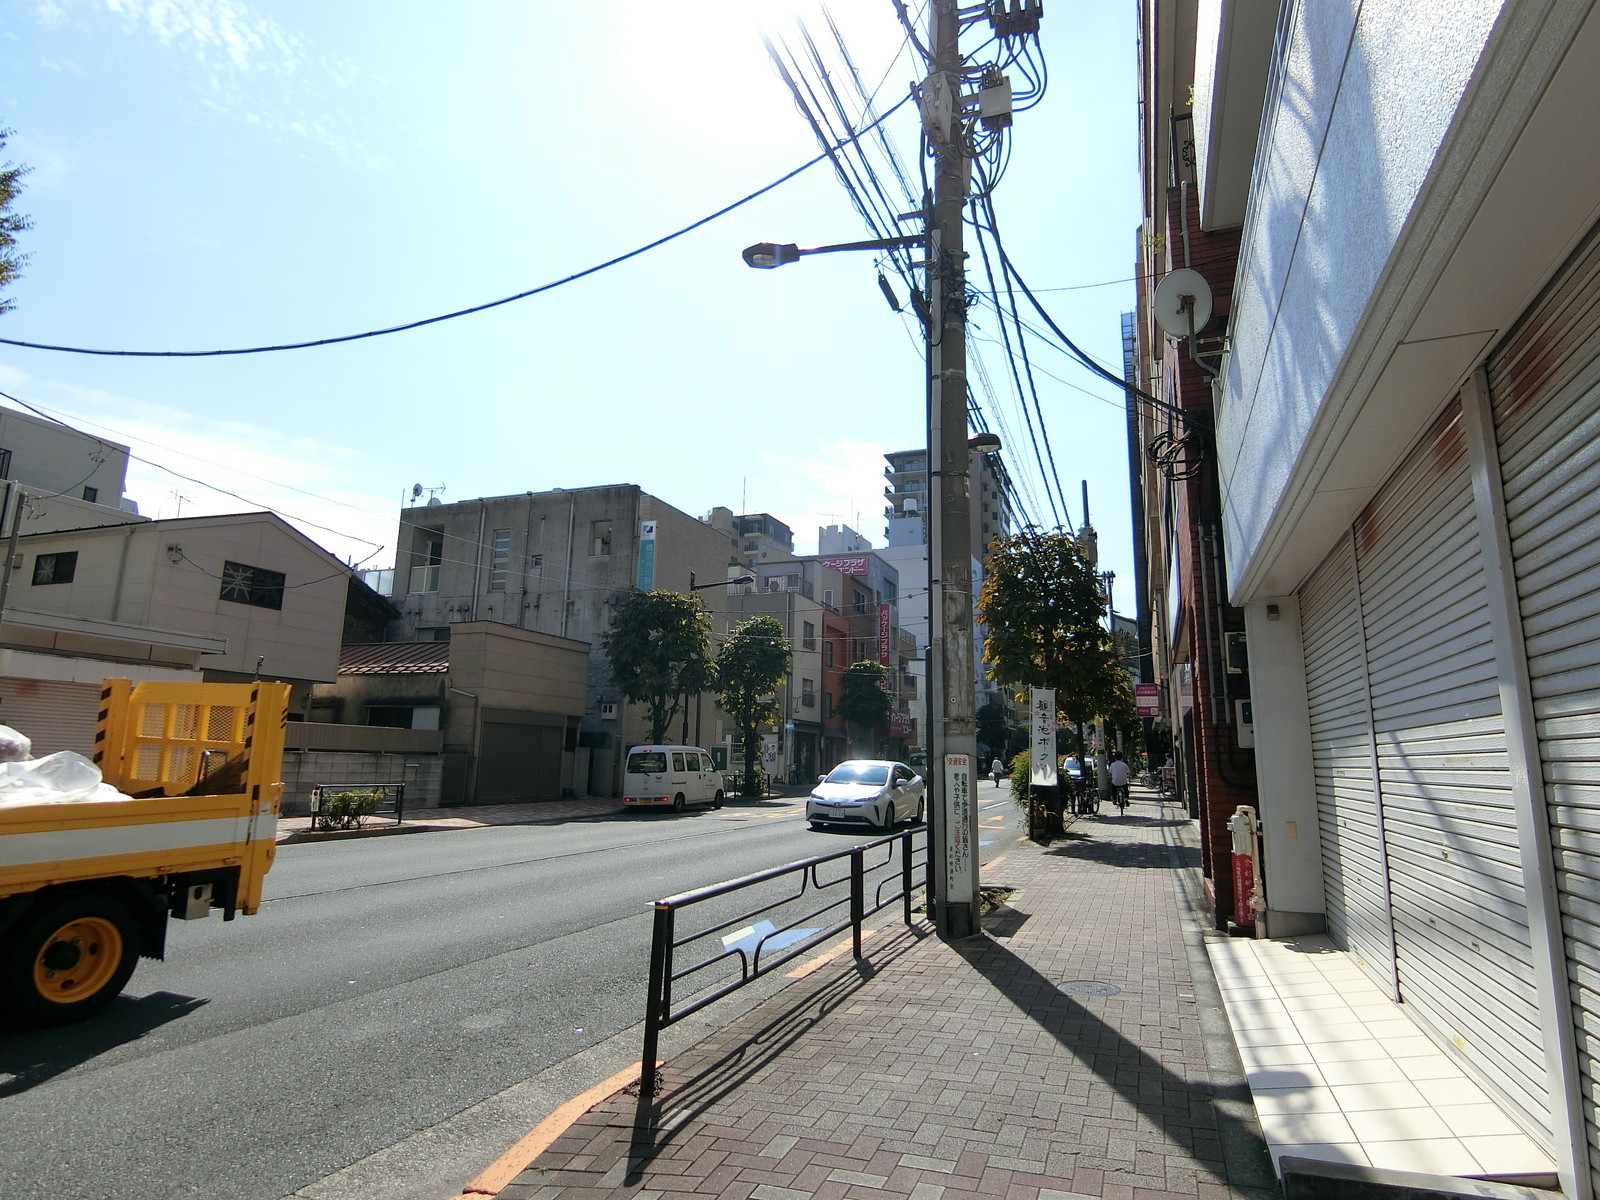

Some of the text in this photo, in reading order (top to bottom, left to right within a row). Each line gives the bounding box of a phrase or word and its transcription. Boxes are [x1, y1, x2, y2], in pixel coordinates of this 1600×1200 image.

[880, 610, 888, 658] パッケージプラザ
[947, 757, 967, 765] 交通安全
